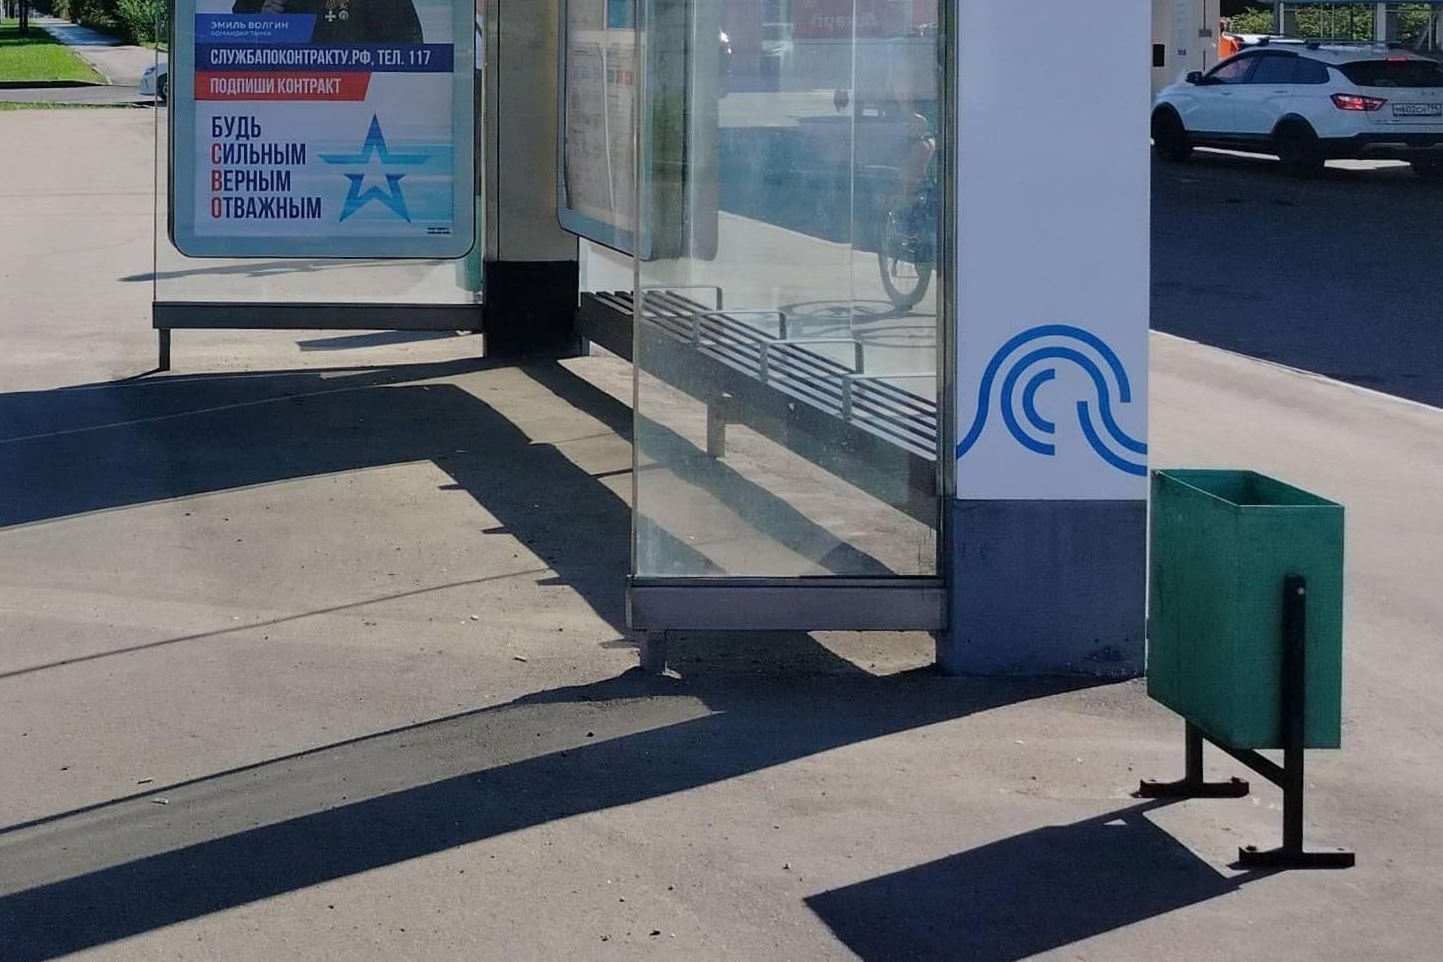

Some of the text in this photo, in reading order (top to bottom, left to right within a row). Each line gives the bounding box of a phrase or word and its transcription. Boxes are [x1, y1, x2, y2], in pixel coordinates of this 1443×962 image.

[210, 21, 288, 29] ЭМИЛЬ ВОЛГИН
[210, 49, 431, 66] СЛУЖБАПОКОНТРАКТУ.РФ, ТЕЛ. 117
[210, 78, 341, 95] ПОДПИШИ КОНТРАКТ
[212, 116, 262, 140] БУДЬ
[211, 143, 306, 165] СИЛЬНЫМ
[211, 170, 291, 192] ВЕРНЫМ
[211, 196, 322, 219] ОТВАЖНЫМ
